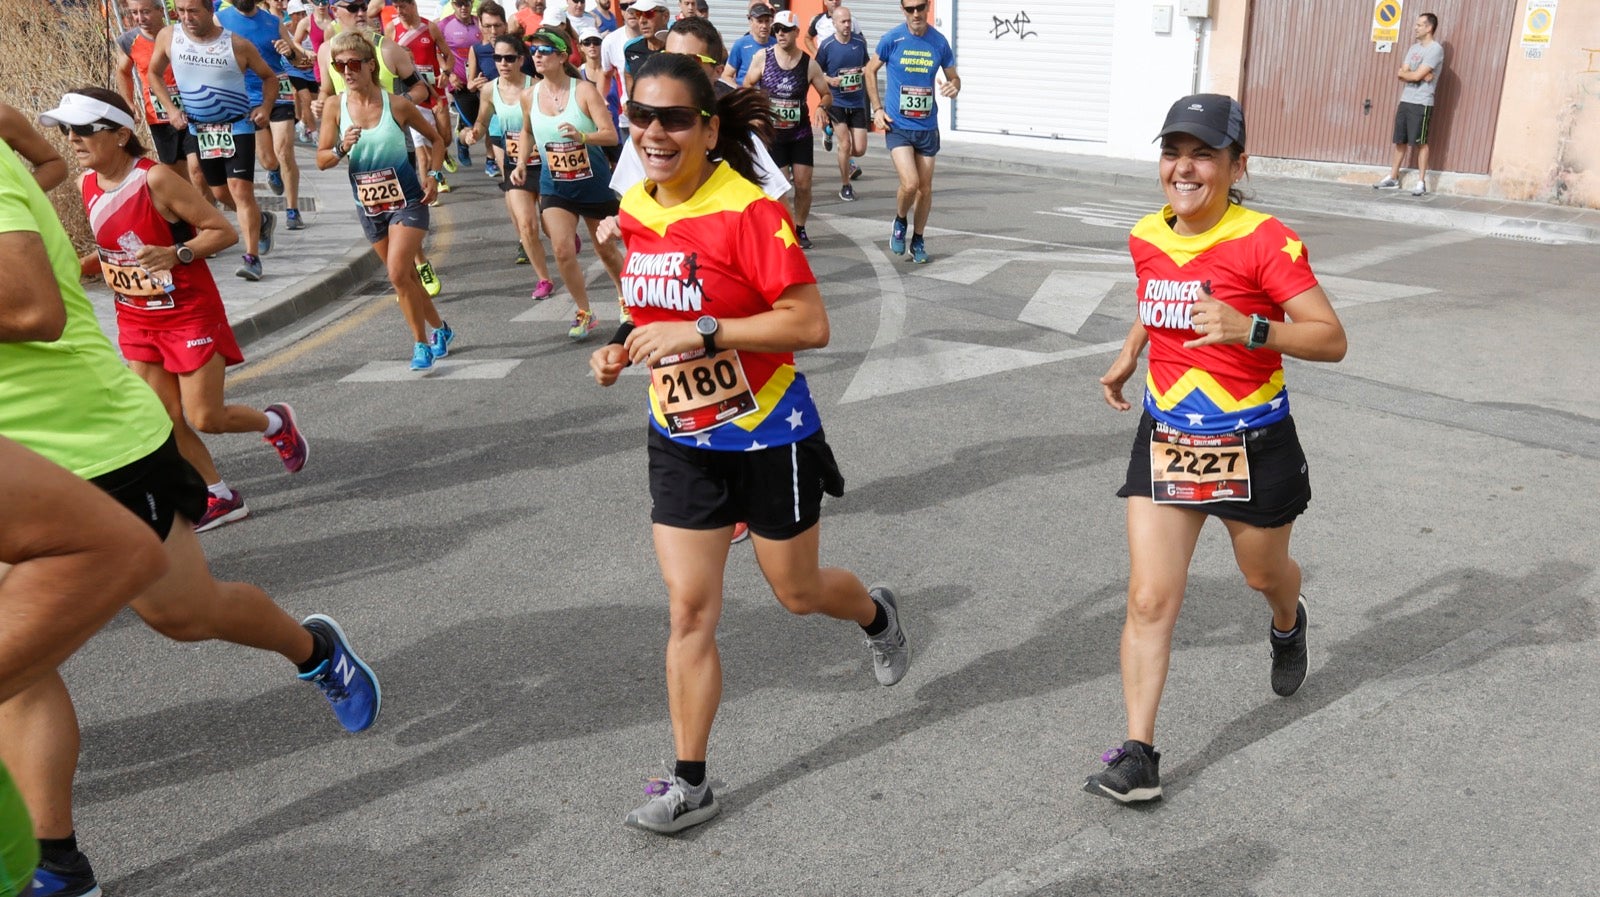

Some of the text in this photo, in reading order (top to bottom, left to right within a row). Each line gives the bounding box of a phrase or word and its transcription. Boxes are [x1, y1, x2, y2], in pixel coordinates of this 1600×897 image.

[179, 53, 228, 66] MARACENA
[901, 57, 934, 67] RUISEÑOR
[843, 74, 860, 85] 746
[906, 96, 928, 109] 331
[199, 133, 233, 148] 1079
[552, 152, 586, 169] 2164
[361, 183, 400, 202] 2226
[625, 251, 686, 277] RUNNER
[620, 275, 704, 312] WOMAN
[1144, 279, 1202, 302] RUNNER
[1139, 300, 1197, 331] WOMA
[662, 359, 738, 404] 2180
[1165, 448, 1240, 476] 2227
